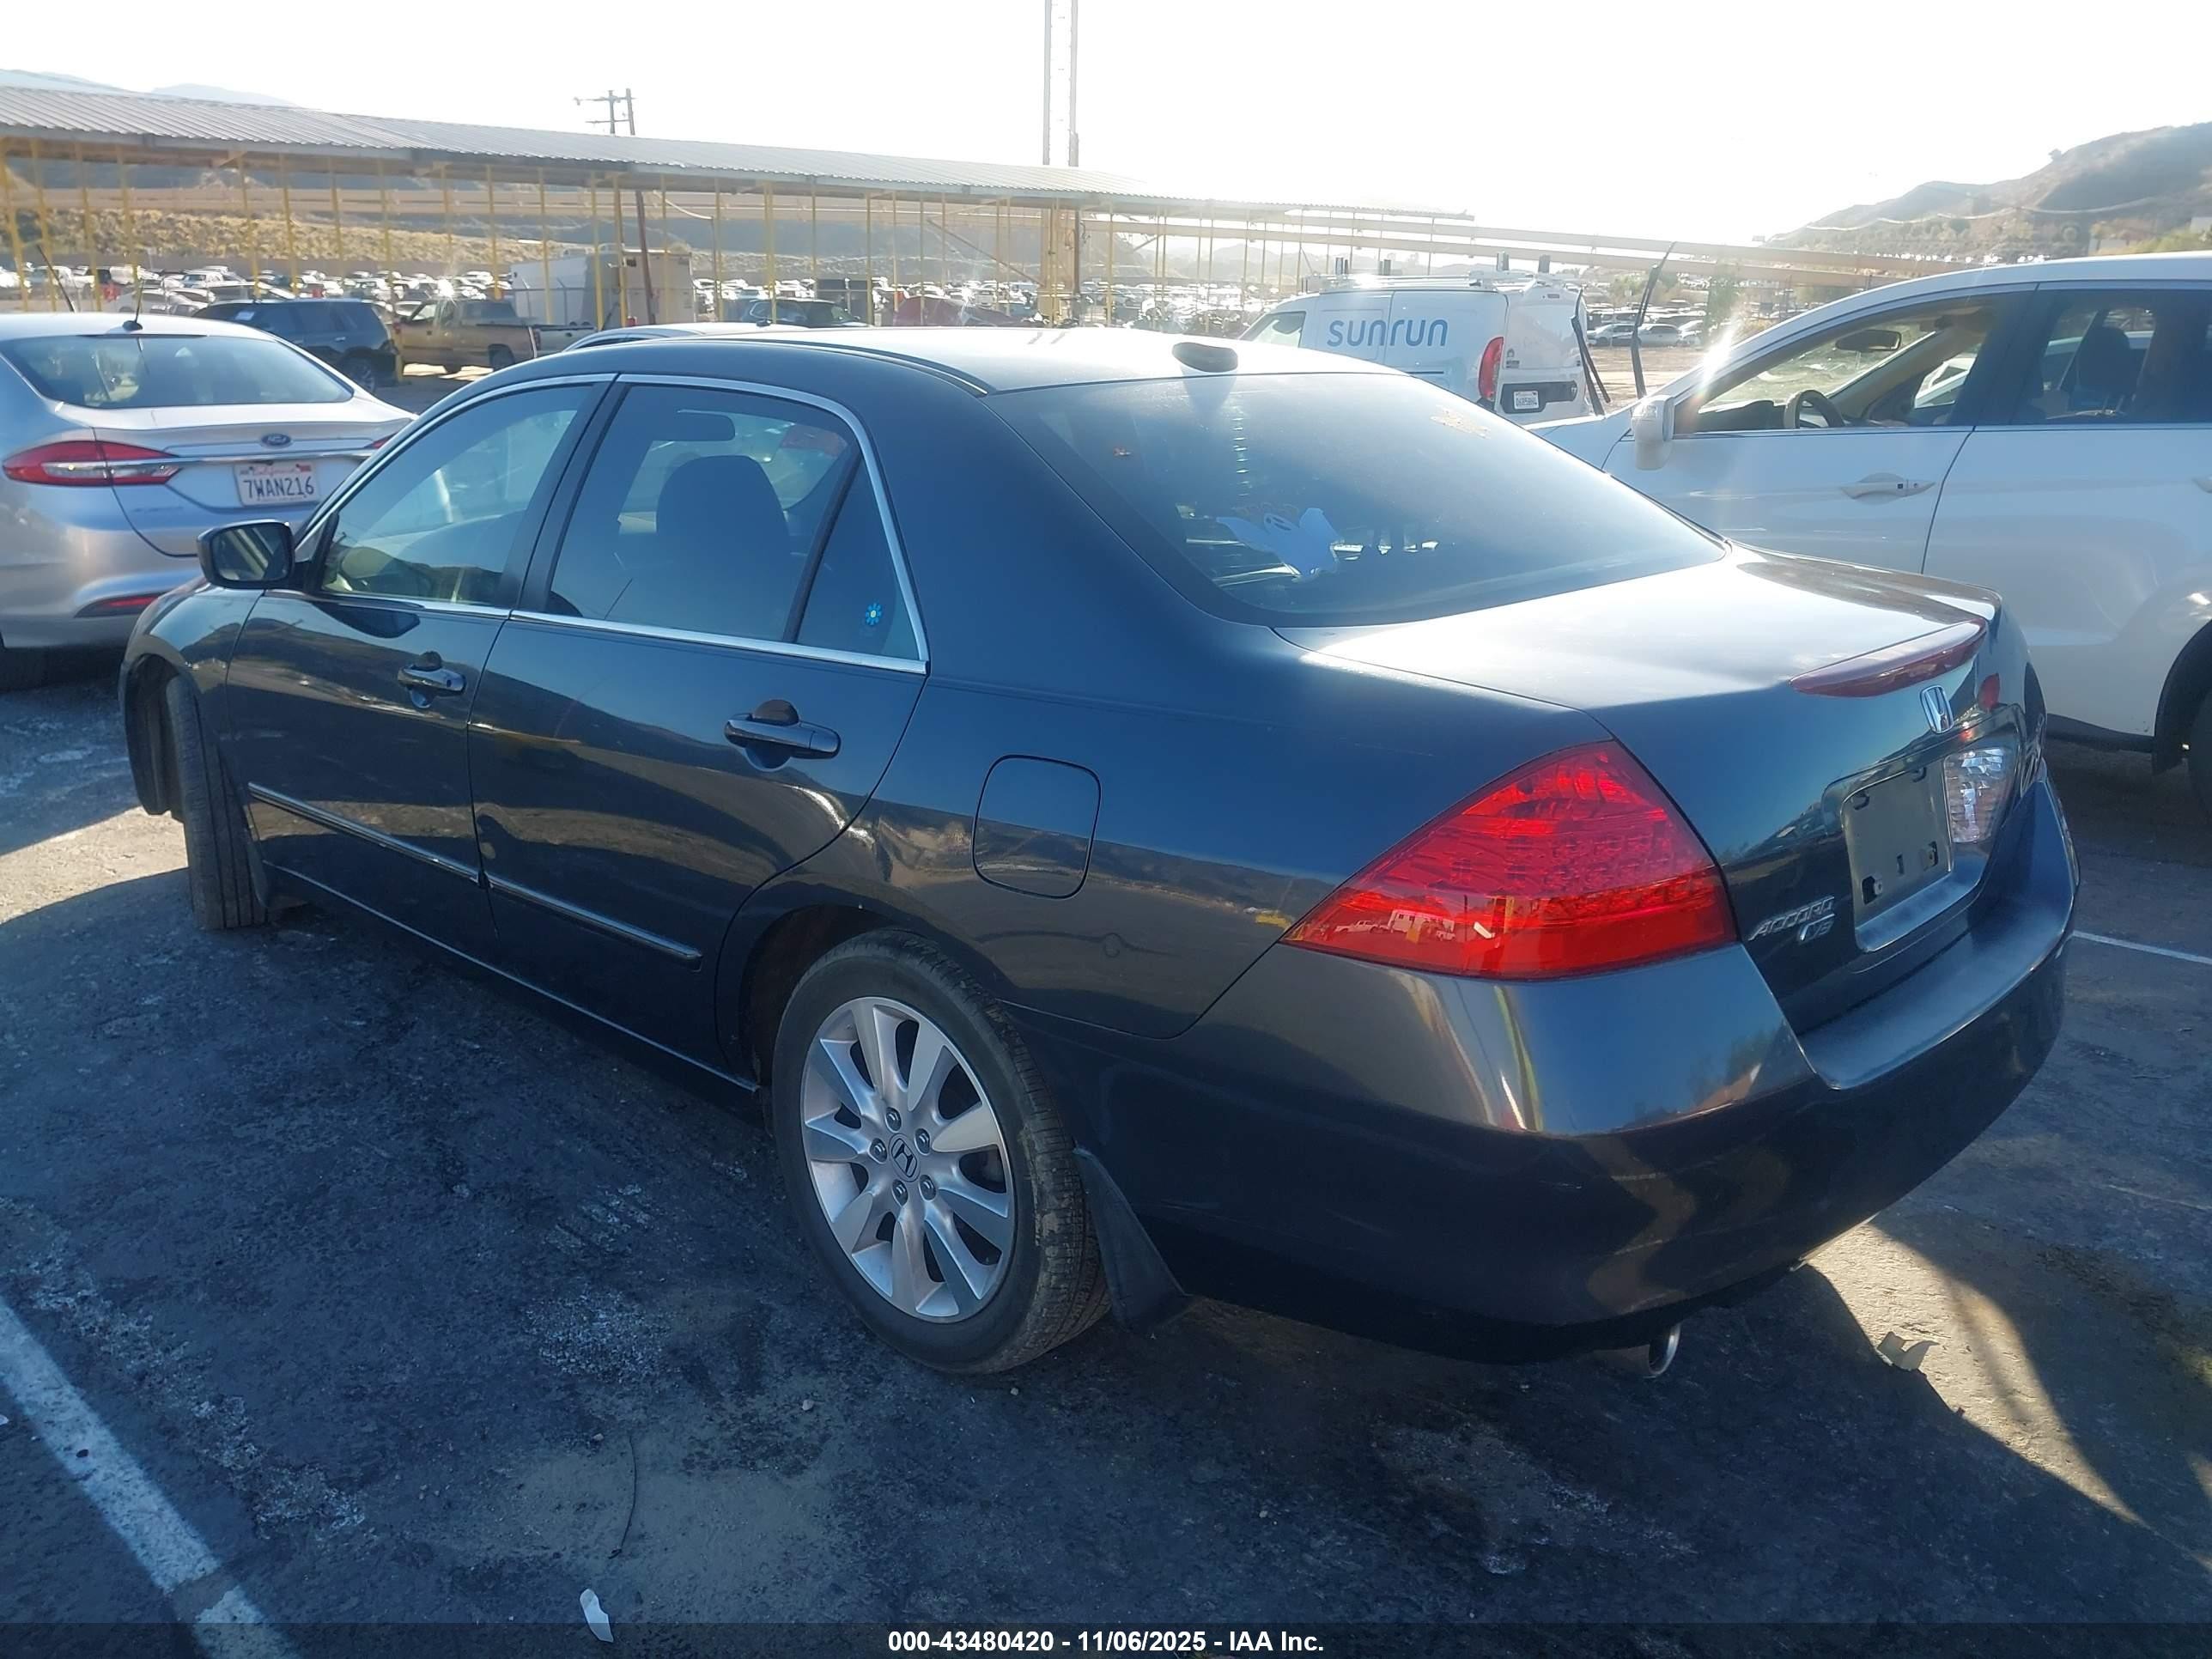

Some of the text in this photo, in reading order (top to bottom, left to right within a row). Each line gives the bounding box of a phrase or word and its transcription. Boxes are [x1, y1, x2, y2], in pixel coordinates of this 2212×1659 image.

[1327, 319, 1449, 347] sunrun
[242, 476, 315, 499] 7WAN216
[1748, 896, 1835, 940] ACCORD
